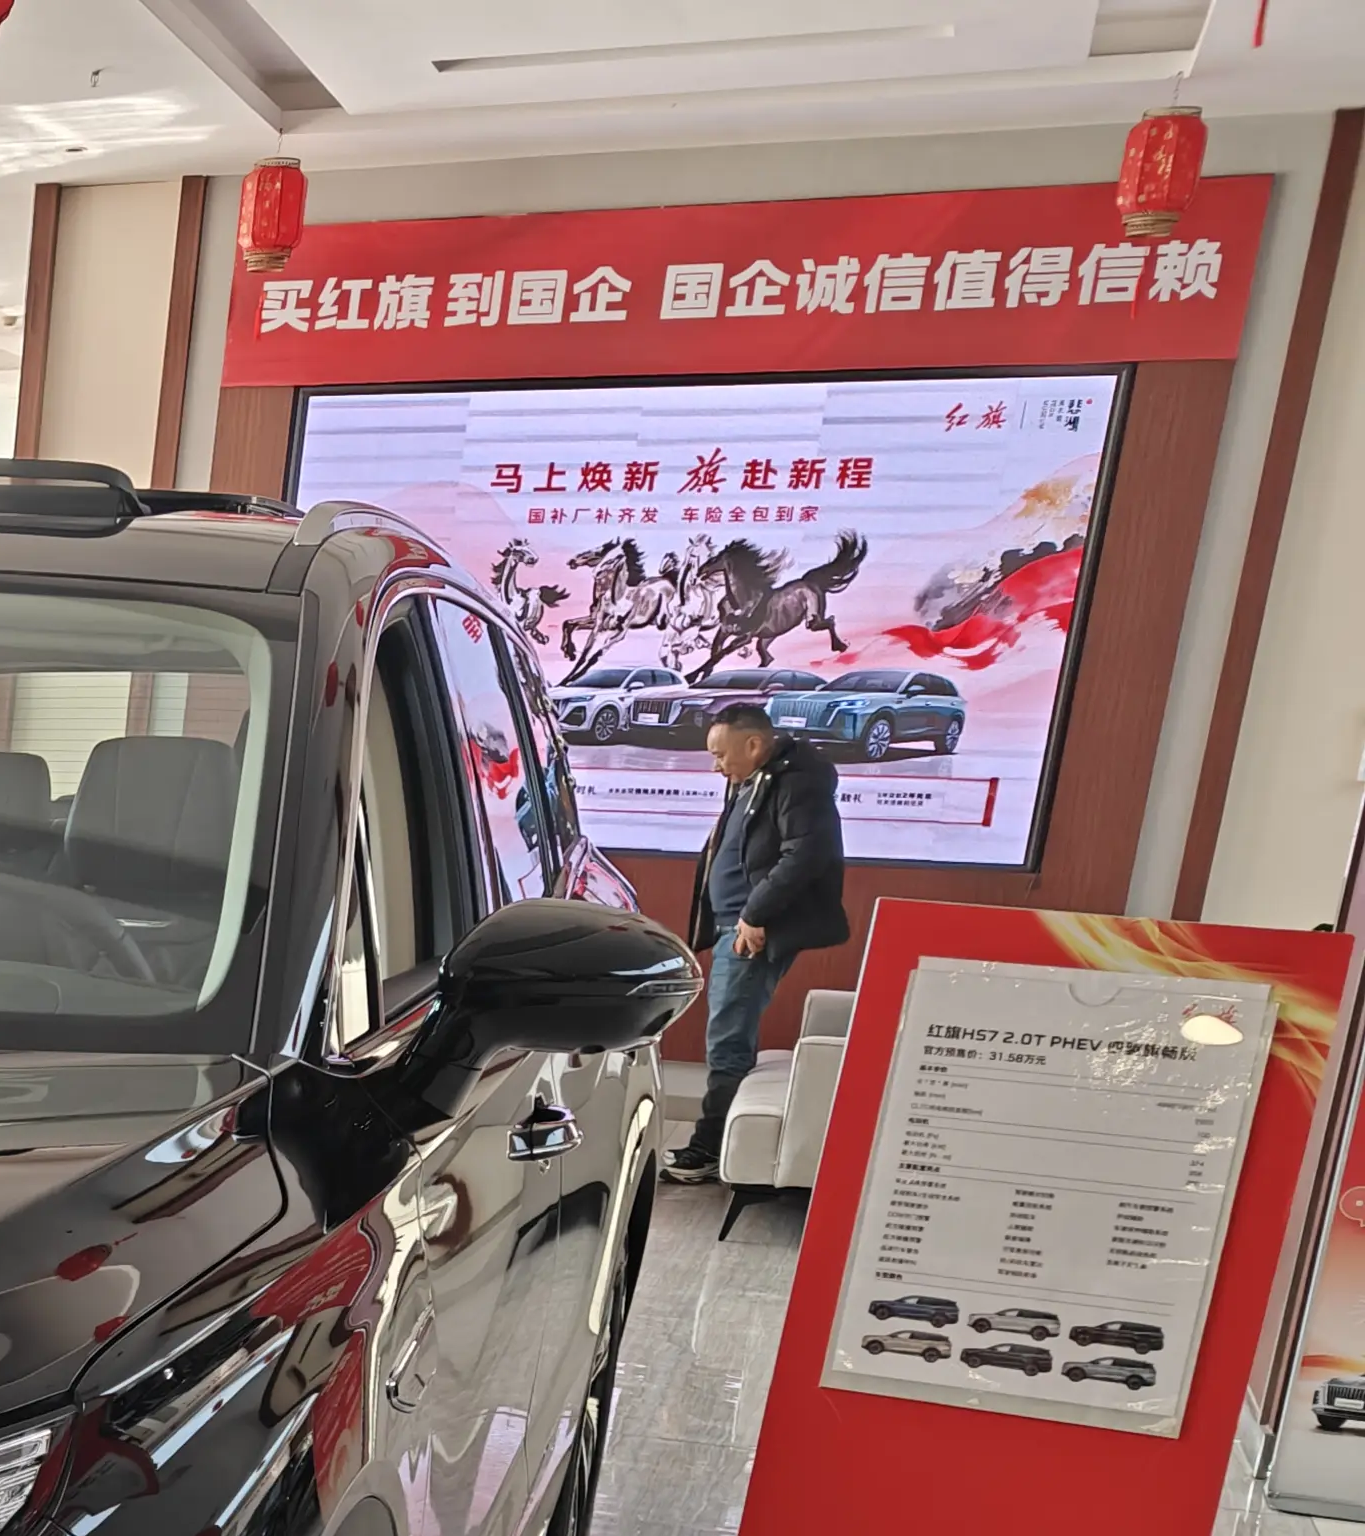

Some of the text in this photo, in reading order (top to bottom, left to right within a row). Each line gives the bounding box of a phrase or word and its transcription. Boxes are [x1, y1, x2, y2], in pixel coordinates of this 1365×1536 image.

[260, 238, 1224, 332] 买红旗到国企 国企诚信值得信赖
[944, 401, 1008, 432] 红旗
[490, 459, 660, 493] 马上焕新
[527, 504, 821, 525] 国补厂补齐发 车险全包到家
[927, 1023, 999, 1042] 红旗HS7
[1002, 1030, 1046, 1048] 2.0T
[1049, 1035, 1103, 1052] PHEV
